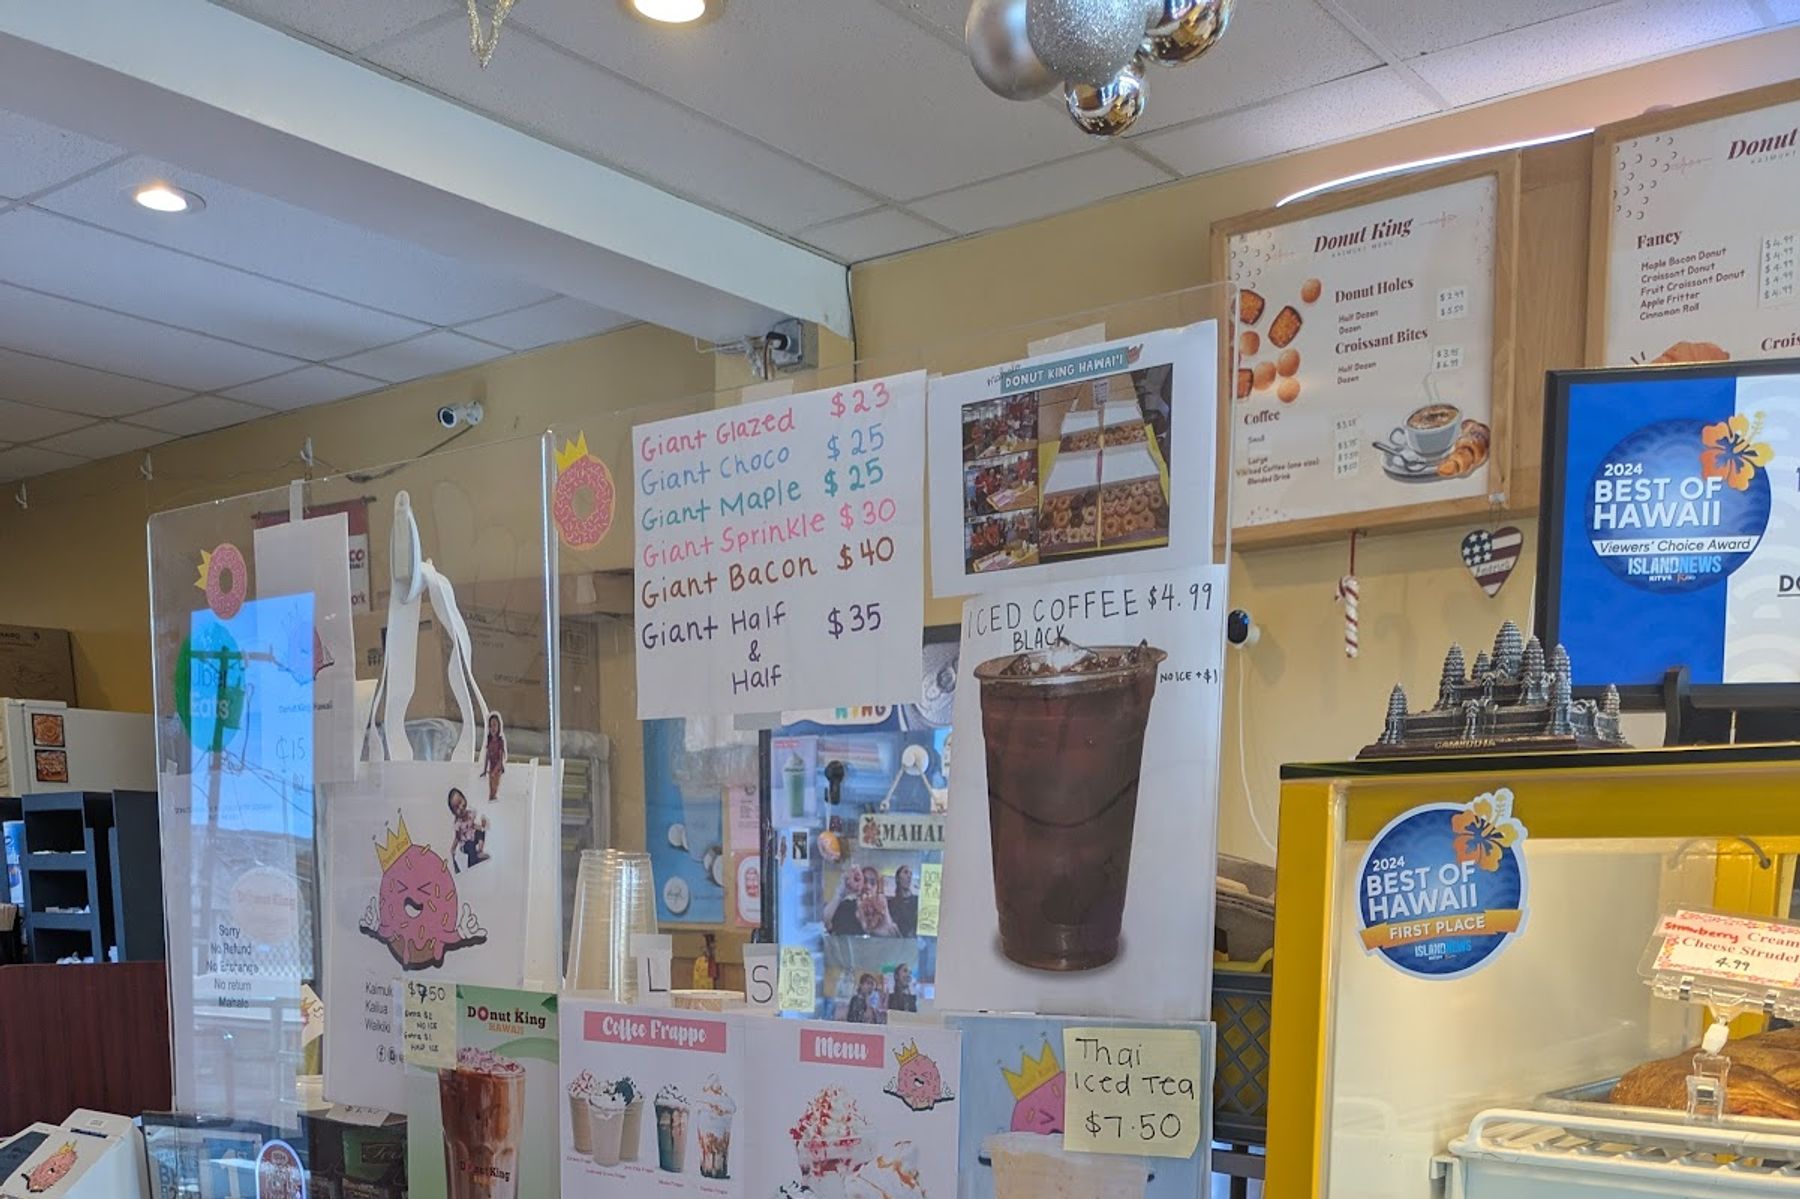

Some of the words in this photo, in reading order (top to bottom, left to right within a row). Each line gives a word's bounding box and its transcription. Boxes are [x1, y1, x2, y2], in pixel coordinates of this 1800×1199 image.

[1727, 128, 1799, 160] Donut
[1314, 226, 1366, 253] Donut
[1371, 217, 1415, 241] King
[1636, 231, 1682, 250] Fancy
[1641, 259, 1667, 273] Maple
[1669, 253, 1697, 267] Bacon
[1698, 248, 1727, 261] Donut
[1641, 269, 1685, 284] Croissant
[1687, 263, 1715, 276] Donut
[1335, 285, 1375, 304] Donut
[1377, 277, 1415, 296] Holes
[1640, 283, 1665, 297] Fruit
[1667, 276, 1713, 292] Croissant
[1716, 269, 1746, 283] Donut
[1639, 307, 1681, 321] Cinnamon
[1682, 303, 1700, 314] Roll
[1640, 296, 1665, 309] Apple
[1666, 291, 1701, 304] Fritter
[1335, 335, 1394, 356] Croissant
[1396, 328, 1429, 345] Bites
[1005, 368, 1043, 389] DONUT
[1047, 364, 1075, 380] KING
[1244, 409, 1281, 425] Coffee
[641, 430, 708, 463] Giant
[715, 407, 796, 446] Glazed
[641, 460, 711, 496] Giant
[719, 446, 790, 479] Choco
[1604, 463, 1643, 477] 2024
[1594, 477, 1672, 504] BEST
[1679, 475, 1723, 501] OF
[641, 499, 712, 532] Giant
[720, 479, 801, 517] Maple
[1593, 500, 1721, 531] HAWAII
[643, 536, 715, 568] Giant
[720, 512, 826, 554] Sprinkle
[1600, 541, 1655, 554] Viewers'
[1657, 539, 1704, 552] Choice
[1707, 537, 1752, 551] Award
[641, 571, 719, 609] Giant
[729, 554, 819, 594] Bacon
[968, 602, 1022, 638] ICED
[1033, 589, 1139, 622] COFFEE
[1148, 582, 1213, 611] $4.99
[641, 612, 719, 650] Giant
[731, 601, 788, 636] Half
[1013, 624, 1065, 652] BLACK
[749, 638, 762, 663] &
[731, 663, 783, 695] Half
[1373, 856, 1405, 871] 2024
[1367, 866, 1430, 897] BEST
[1438, 860, 1476, 886] OF
[1368, 883, 1478, 922] HAWAII
[218, 925, 241, 939] Sorry
[1389, 922, 1431, 940] FIRST
[1436, 915, 1486, 934] PLACE
[1664, 921, 1740, 944] Strawberry
[1747, 931, 1800, 949] Cream
[210, 942, 222, 955] No
[1682, 936, 1737, 953] Cheese
[1741, 945, 1800, 963] Strudel
[207, 961, 218, 972] No
[646, 957, 668, 992] L
[1715, 957, 1751, 972] 4.99
[214, 978, 226, 989] No
[751, 965, 774, 1004] S
[514, 1009, 547, 1029] King
[602, 1016, 647, 1041] Coffee
[651, 1020, 707, 1047] Frappe
[814, 1036, 868, 1060] Menu
[1075, 1037, 1143, 1067] Thai
[1085, 1110, 1182, 1140] $7.50
